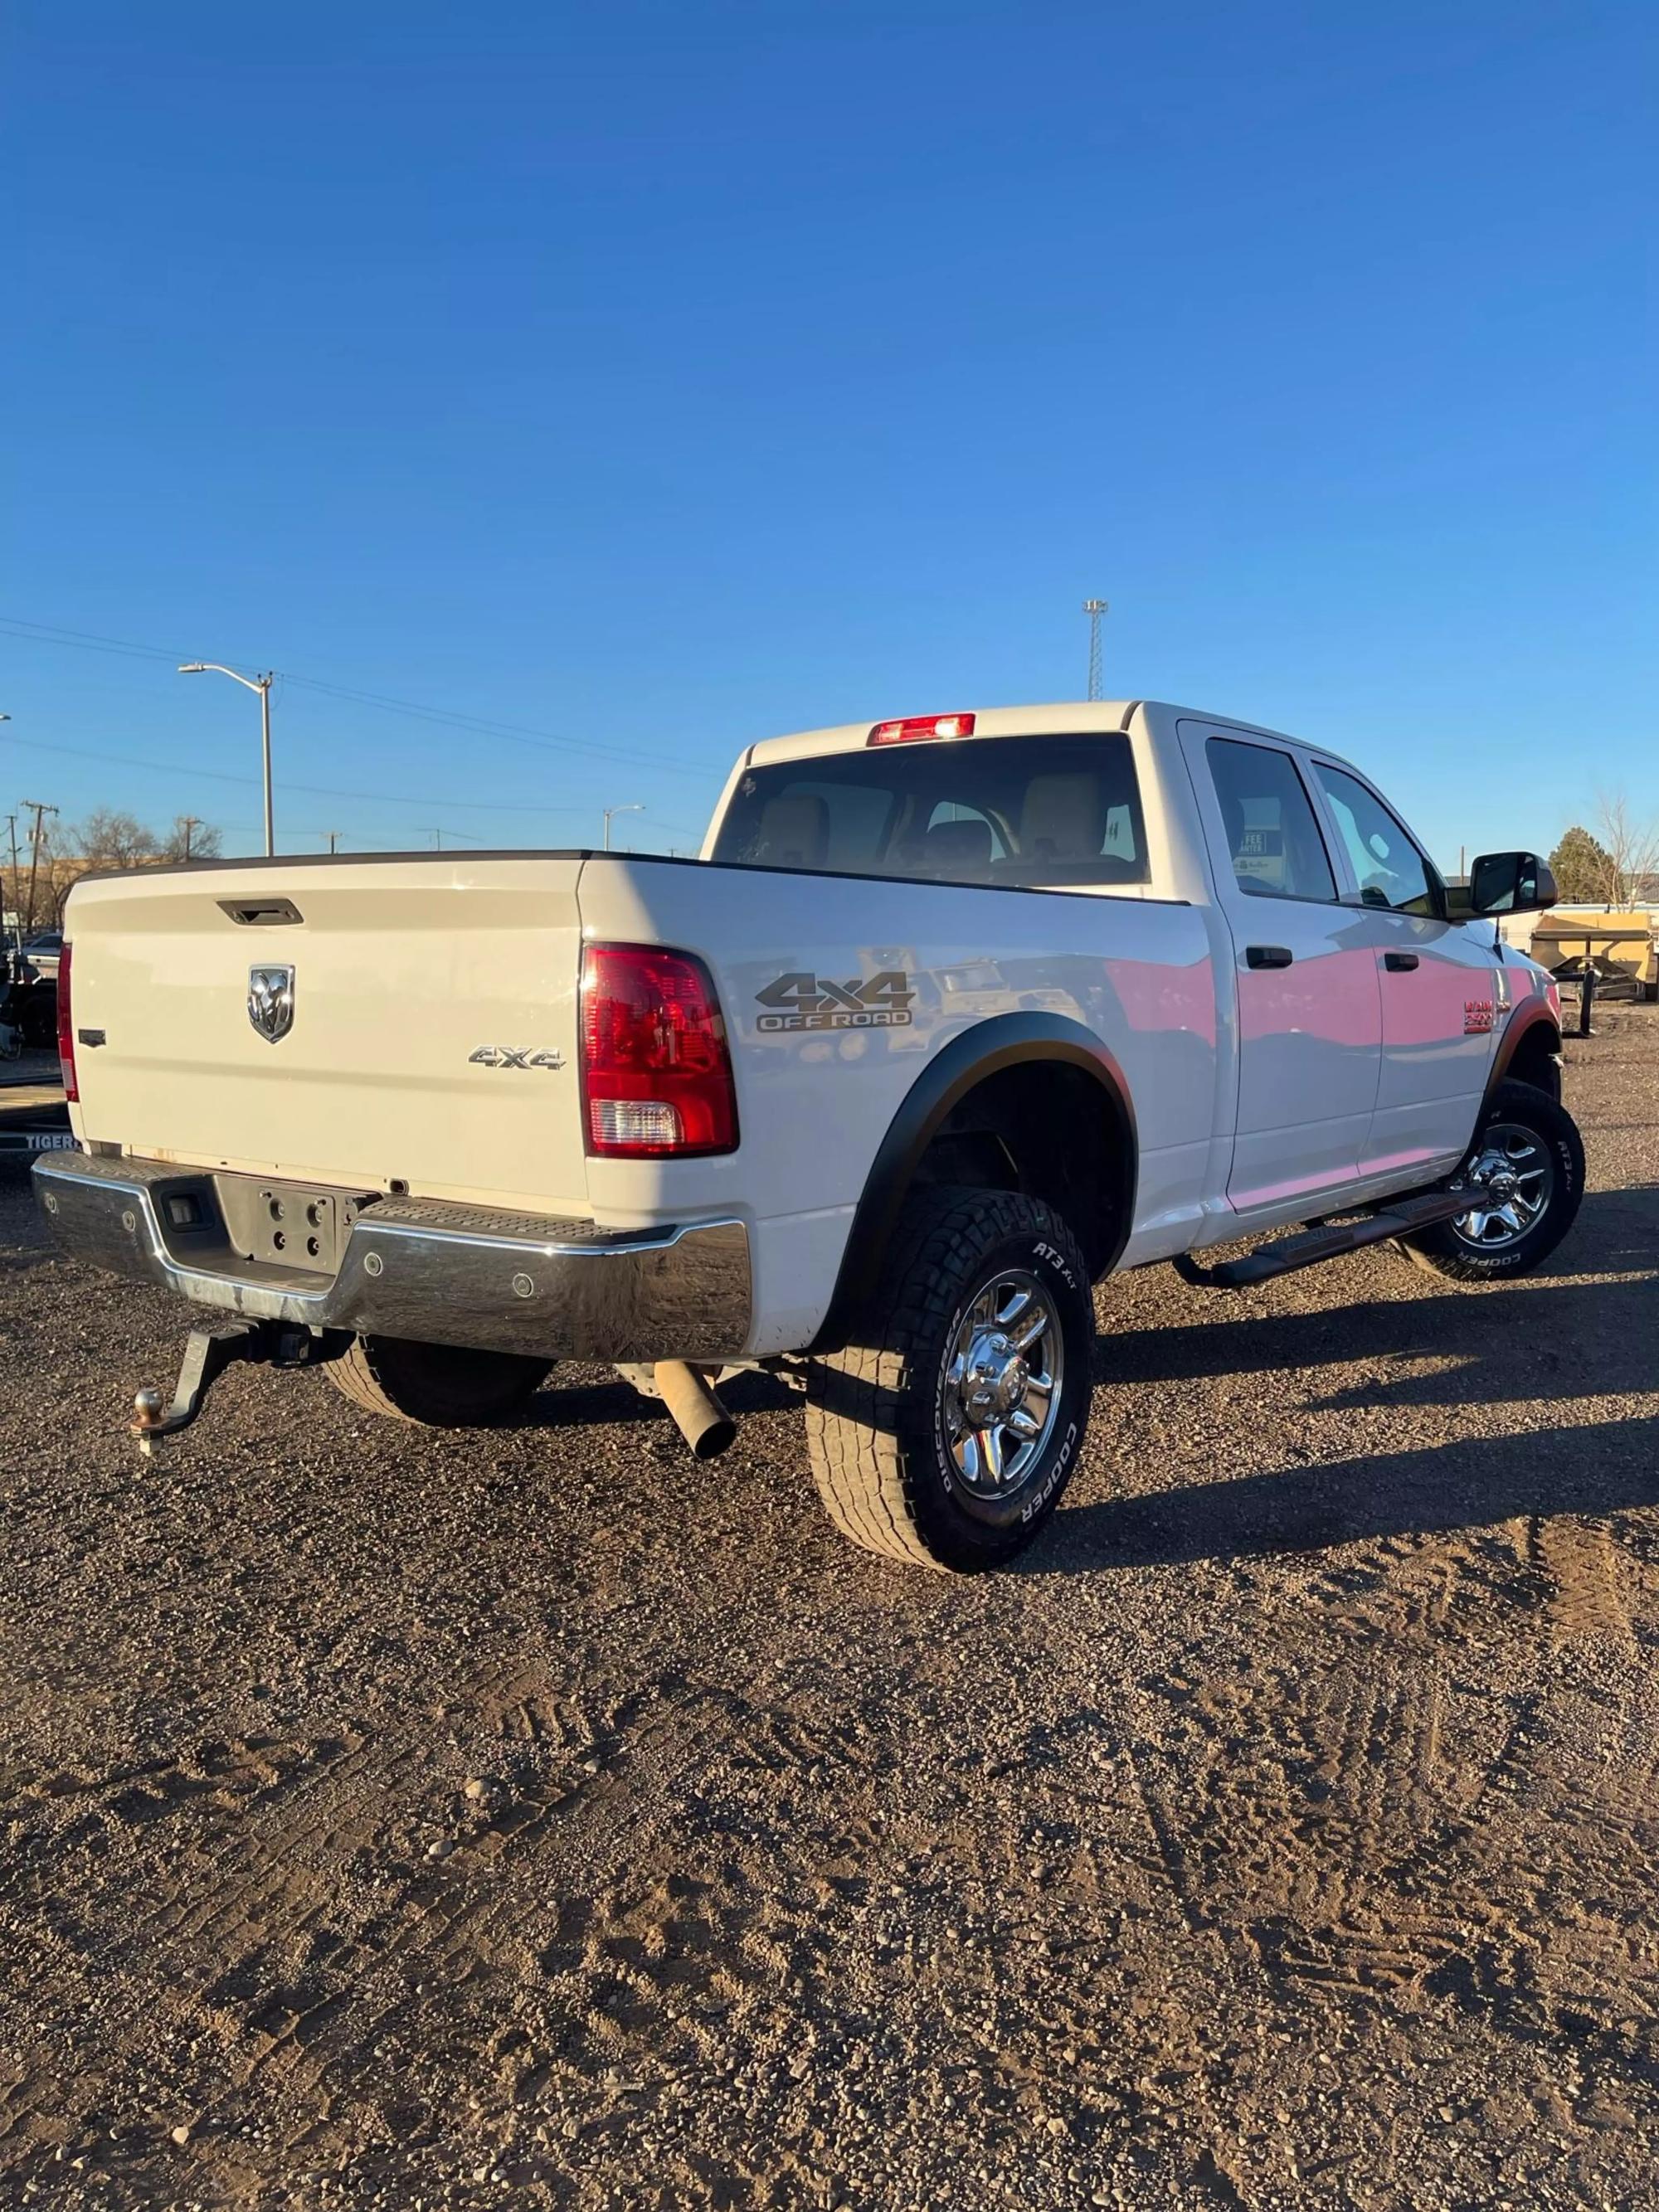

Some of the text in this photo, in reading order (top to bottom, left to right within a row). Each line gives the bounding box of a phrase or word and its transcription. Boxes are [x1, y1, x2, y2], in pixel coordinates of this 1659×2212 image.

[760, 1011, 911, 1030] OFF ROAD
[1032, 1242, 1077, 1289] AT3 XLT
[1457, 1251, 1521, 1267] COOPER
[1021, 1422, 1078, 1524] COOPER
